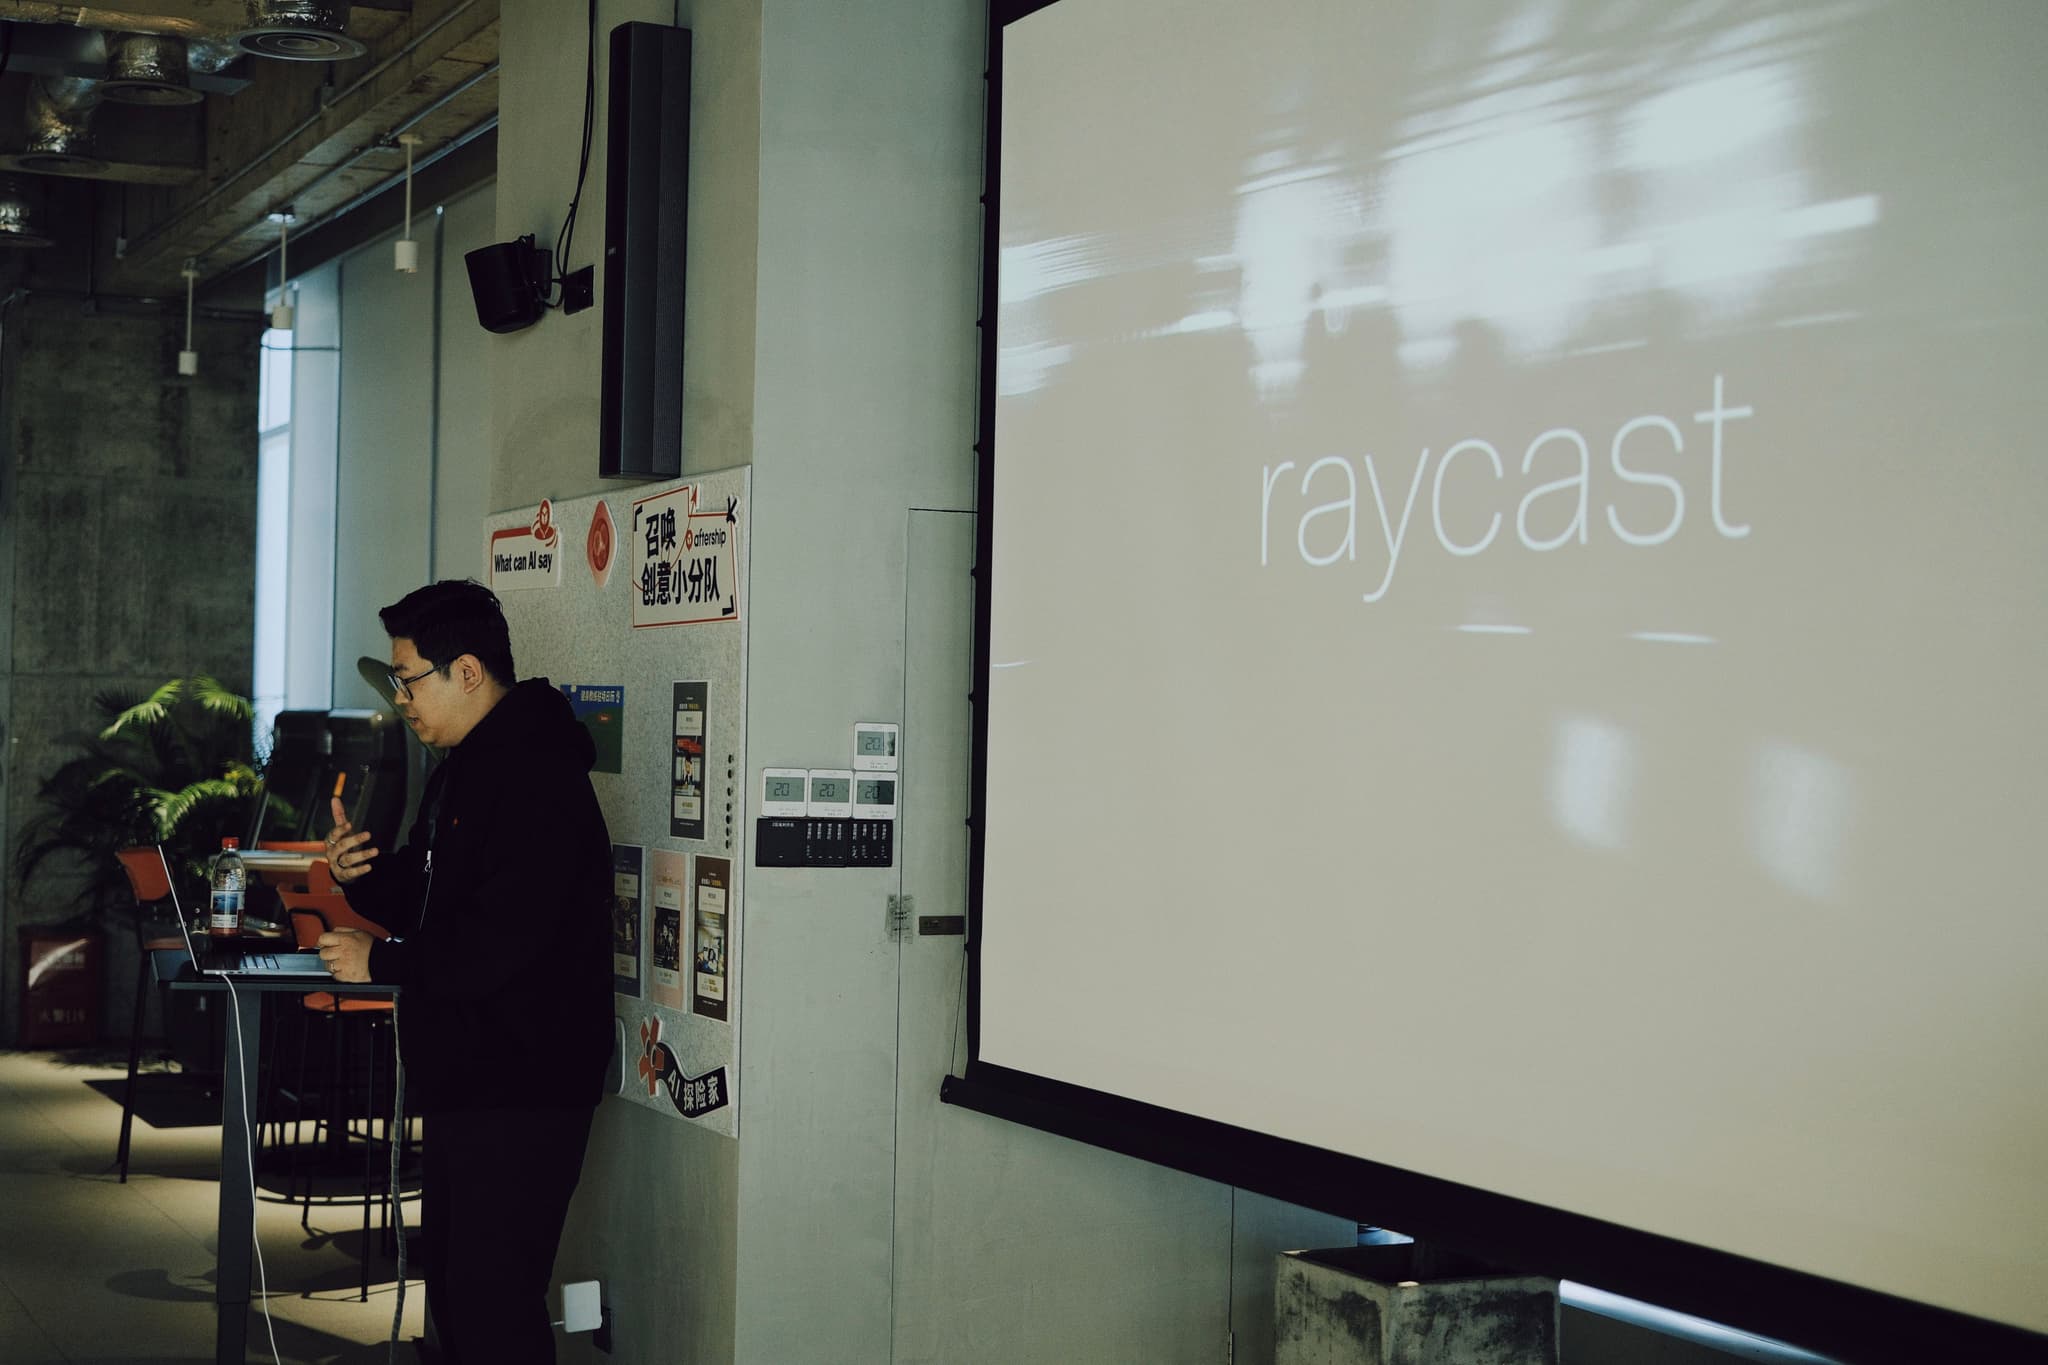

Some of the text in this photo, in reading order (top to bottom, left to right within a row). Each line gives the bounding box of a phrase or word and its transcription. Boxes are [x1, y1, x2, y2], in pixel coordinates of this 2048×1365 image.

[1261, 374, 1754, 603] raycast
[645, 506, 677, 559] 召唤
[693, 529, 727, 548] aftership
[494, 551, 553, 574] What can AI say
[641, 555, 721, 607] 创意小分队
[774, 782, 790, 797] 20
[819, 783, 835, 798] 20
